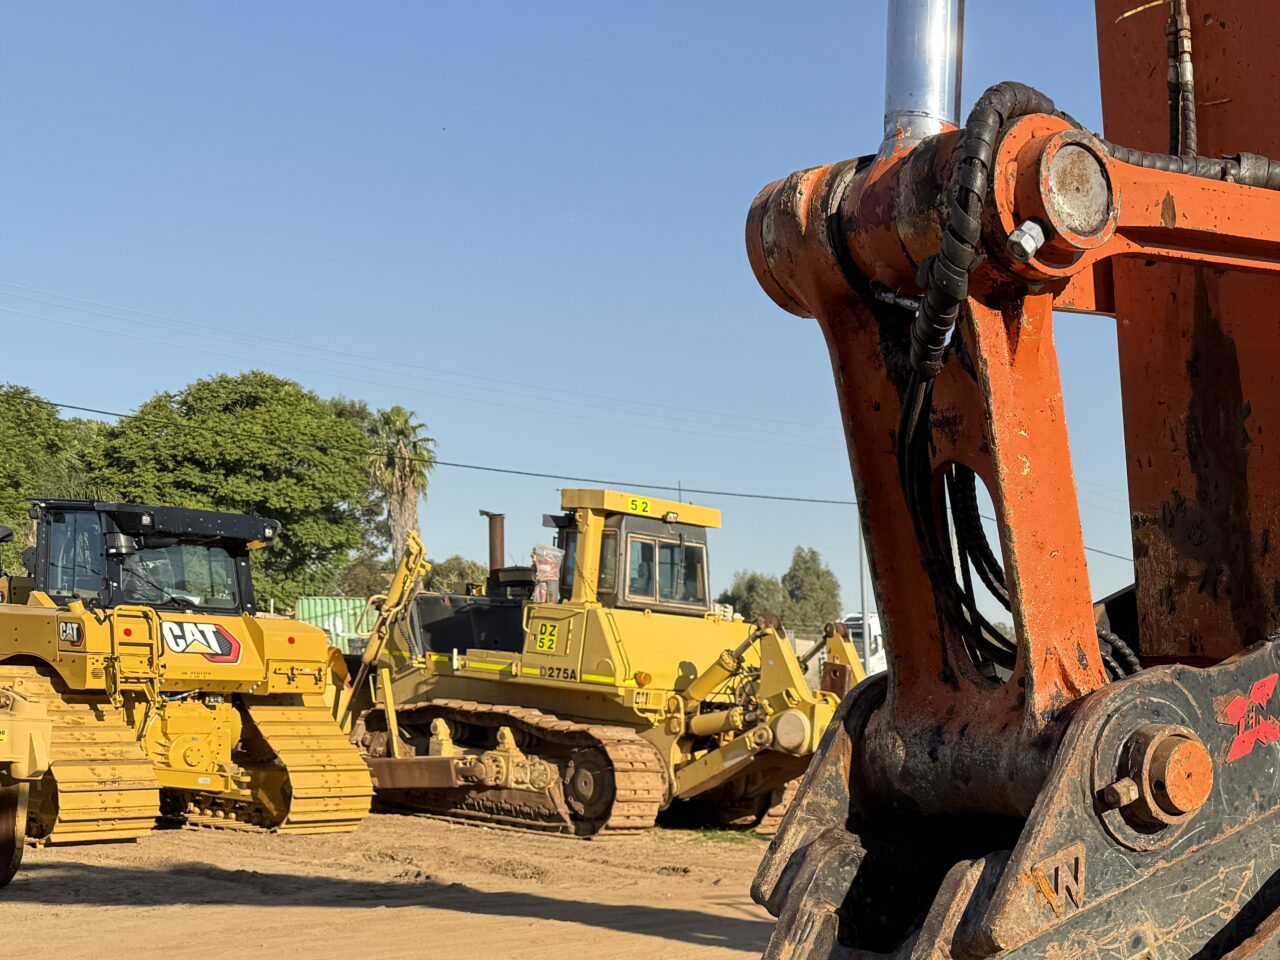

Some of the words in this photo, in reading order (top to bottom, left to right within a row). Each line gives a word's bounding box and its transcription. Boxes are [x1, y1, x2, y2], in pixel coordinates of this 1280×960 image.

[59, 622, 78, 641] CAT
[162, 621, 222, 654] CAT
[540, 666, 577, 680] D275A
